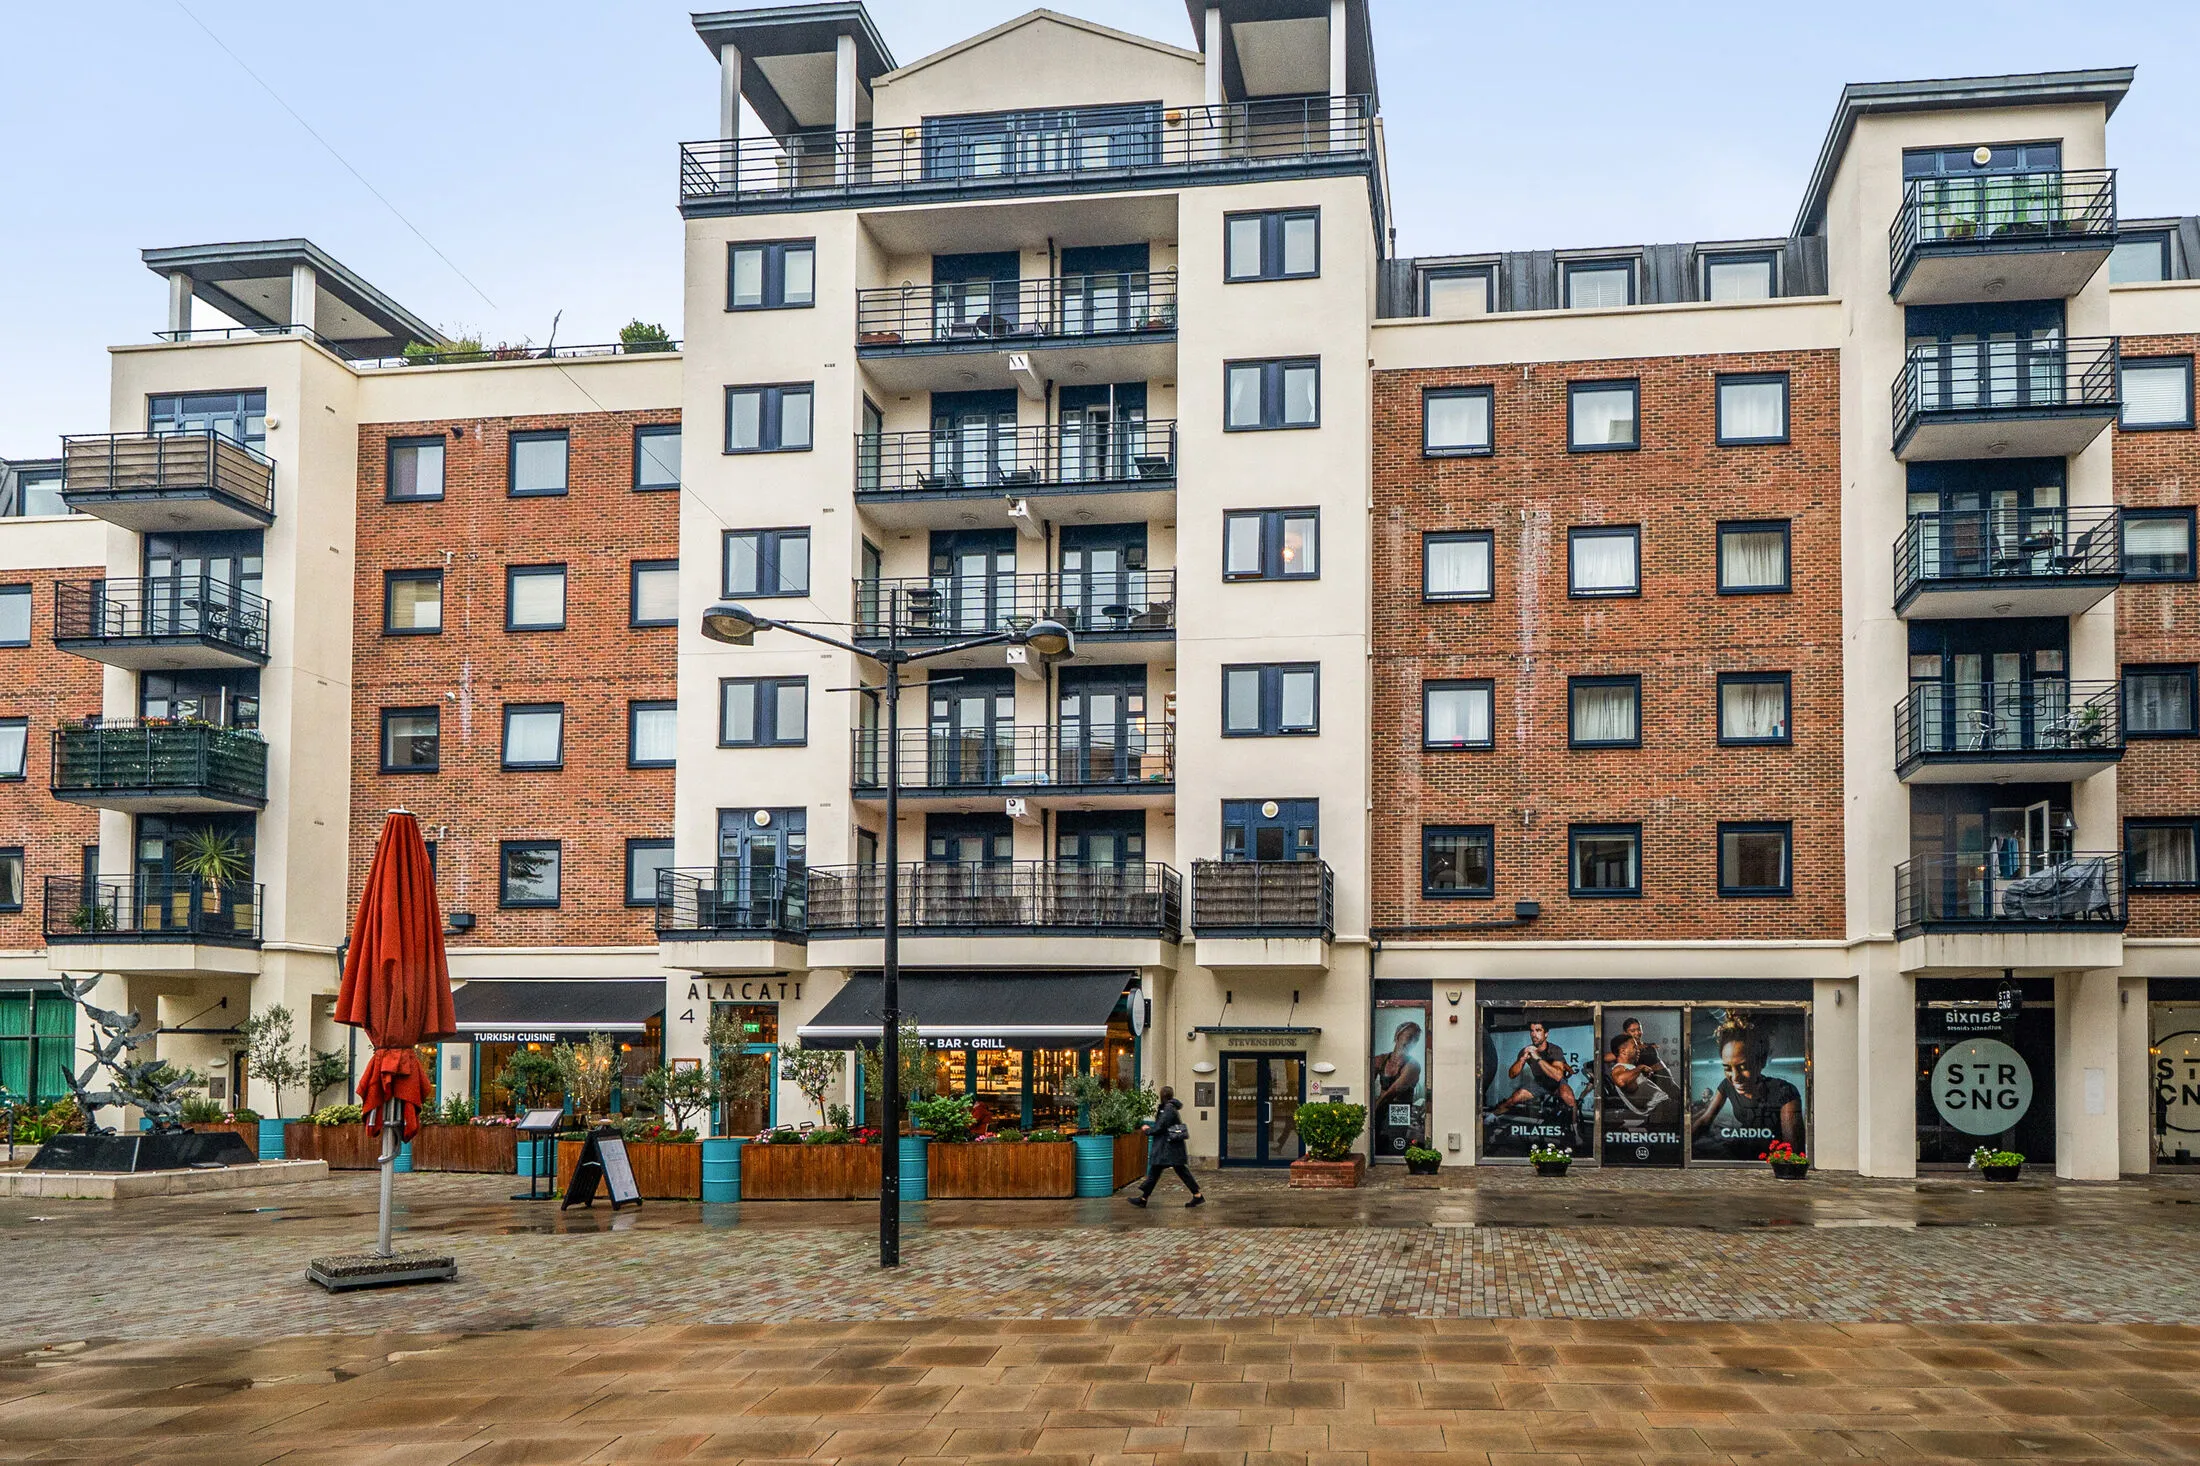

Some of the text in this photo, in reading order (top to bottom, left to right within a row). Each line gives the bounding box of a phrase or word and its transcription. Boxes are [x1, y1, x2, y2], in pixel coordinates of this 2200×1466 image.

[687, 982, 802, 1000] ALACATI
[679, 1008, 695, 1024] 4
[474, 1032, 556, 1041] TURKISH CUISINE
[937, 1038, 962, 1048] BAR
[971, 1038, 1005, 1048] GRILL
[1228, 1038, 1297, 1047] STEVENS HOUSE
[1947, 1063, 2016, 1085] STR
[1945, 1088, 2020, 1110] ONG
[1511, 1125, 1565, 1136] PILATES.
[1721, 1127, 1775, 1138] CARDIO.
[1605, 1132, 1680, 1143] STRENGTH.
